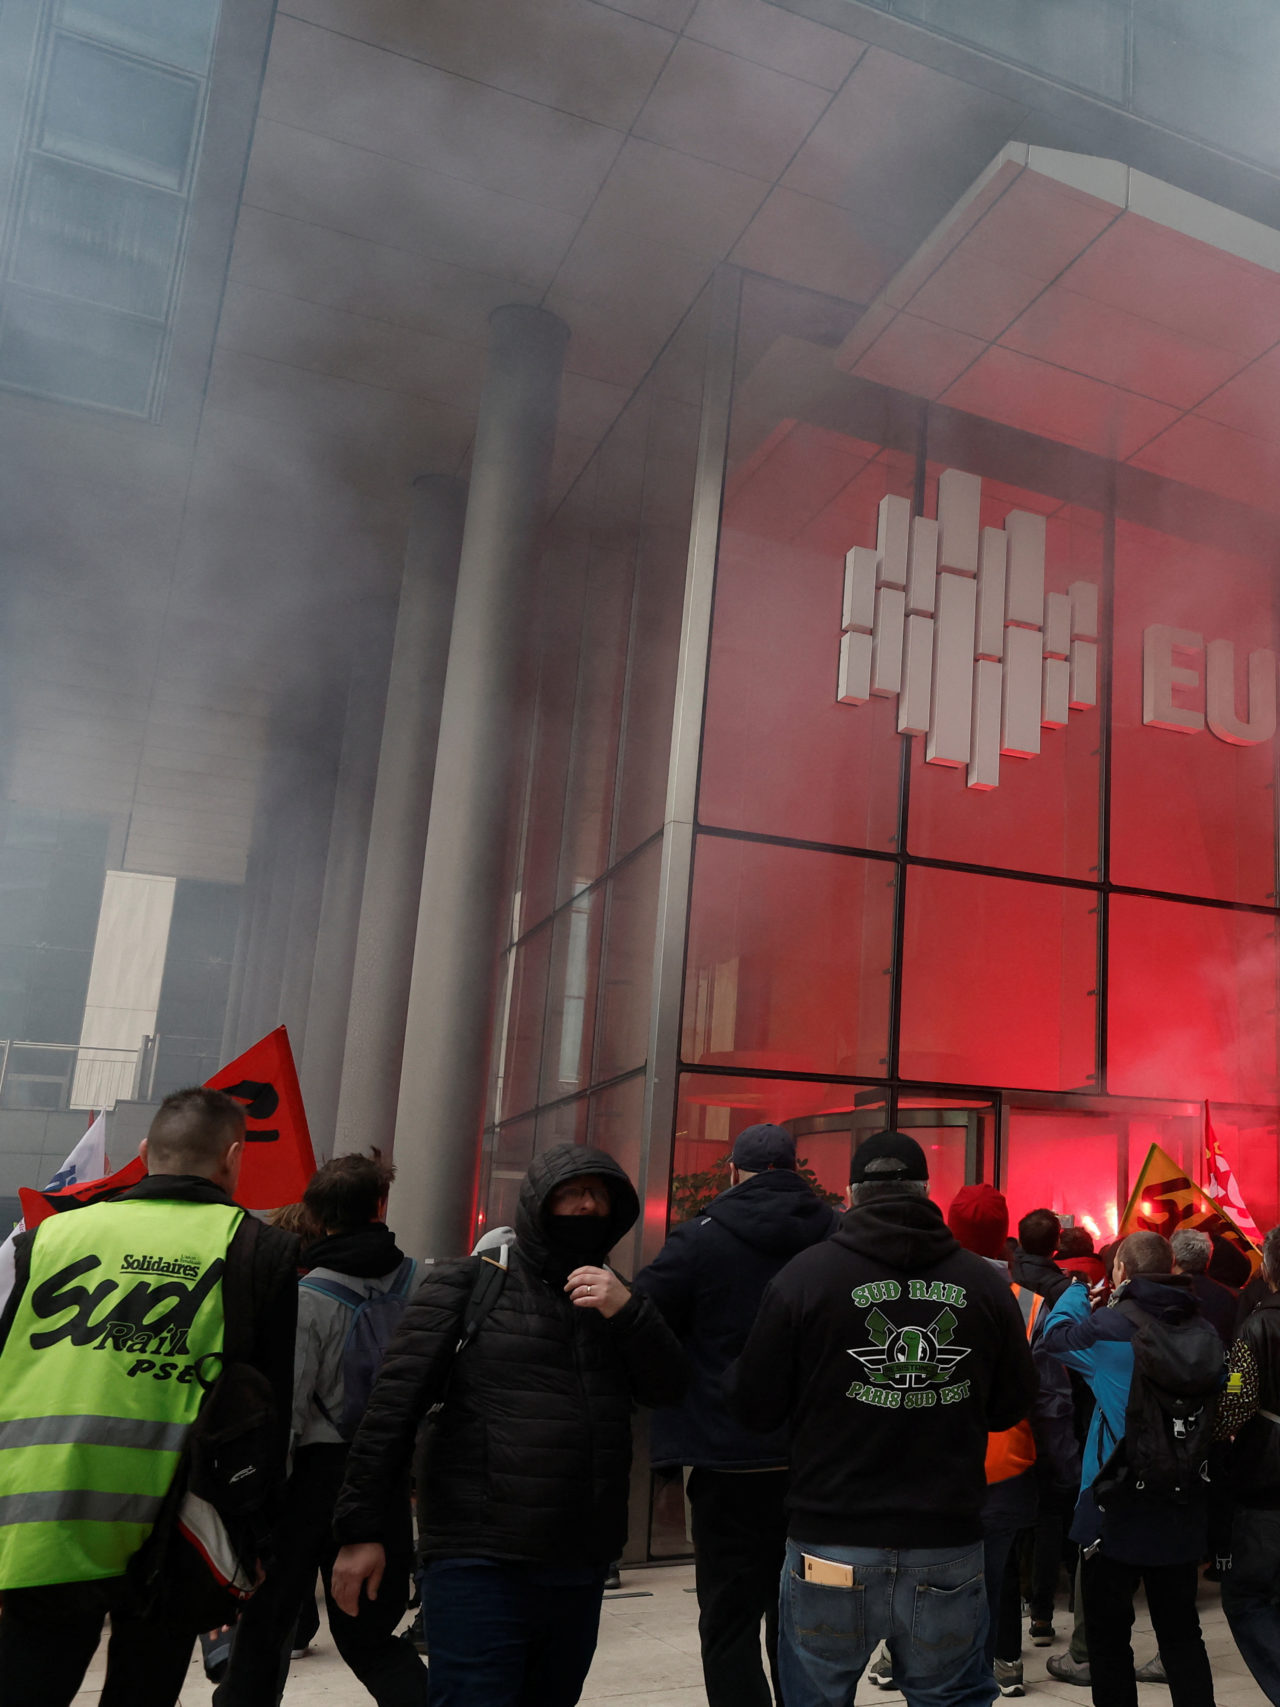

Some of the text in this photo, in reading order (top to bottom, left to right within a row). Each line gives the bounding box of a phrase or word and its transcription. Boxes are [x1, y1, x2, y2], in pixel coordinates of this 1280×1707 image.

[121, 1254, 200, 1277] Solidaires
[30, 1254, 224, 1350] Sud
[851, 1279, 968, 1308] SUD RAIL
[93, 1321, 191, 1356] Rail
[126, 1358, 198, 1384] PSE
[846, 1379, 971, 1409] PARIS SUD EST
